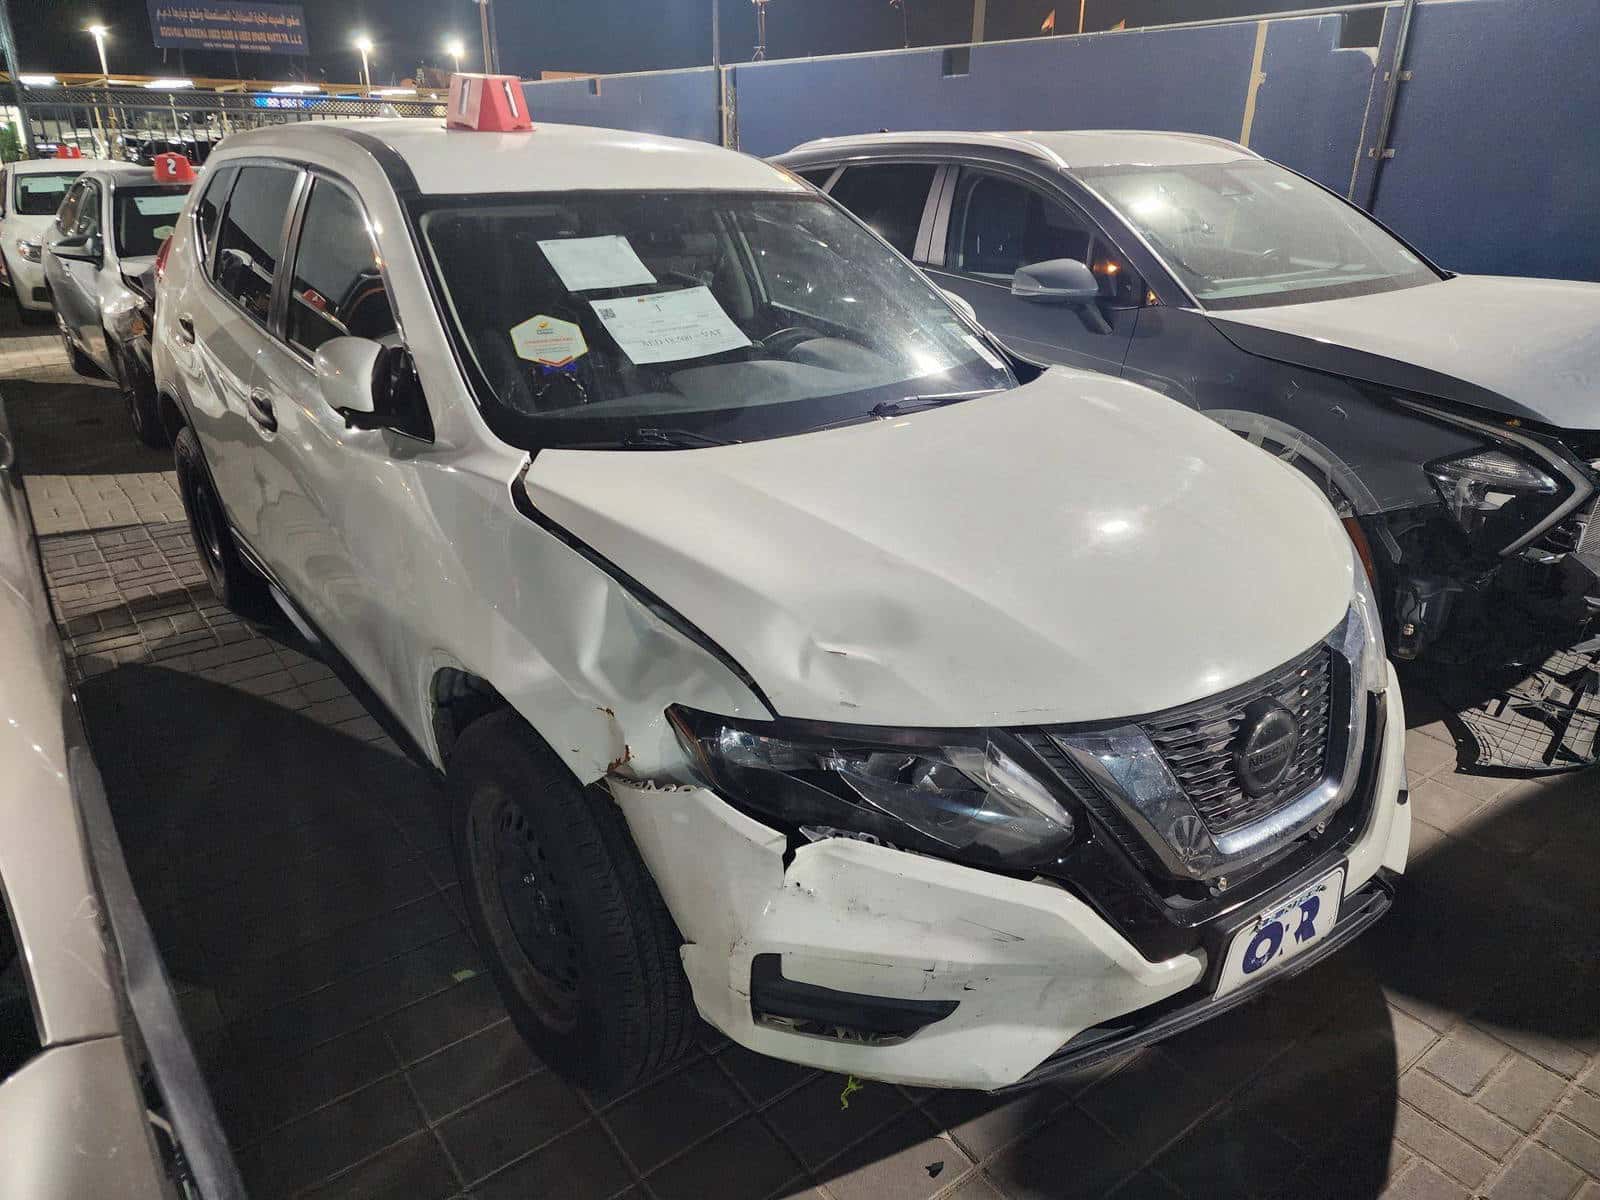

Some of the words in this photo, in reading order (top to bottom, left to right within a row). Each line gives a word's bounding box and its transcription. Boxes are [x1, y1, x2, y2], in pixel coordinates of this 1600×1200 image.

[460, 80, 470, 114] 1
[503, 80, 519, 118] 1
[166, 158, 177, 175] 2
[1248, 736, 1295, 769] NISSAN
